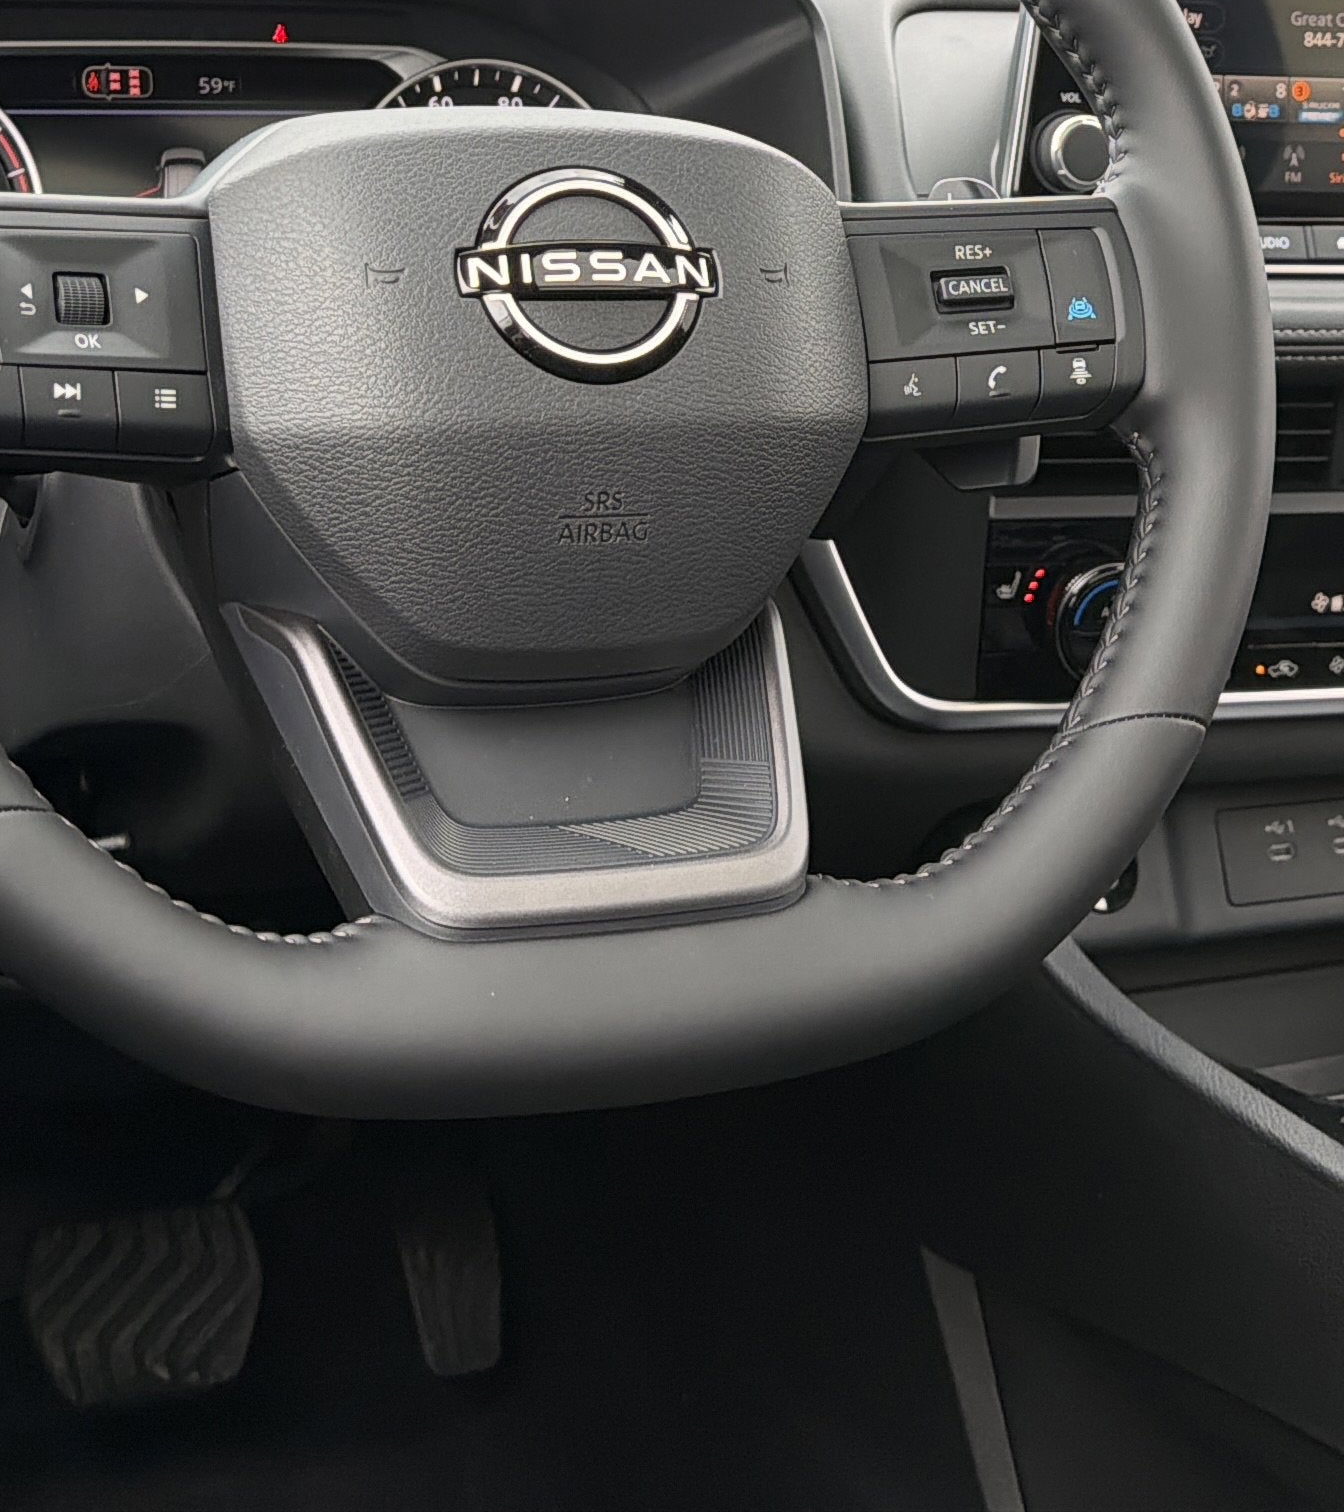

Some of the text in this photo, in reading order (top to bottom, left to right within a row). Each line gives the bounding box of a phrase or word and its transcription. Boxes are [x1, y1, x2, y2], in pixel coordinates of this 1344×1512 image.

[1290, 11, 1332, 28] Great
[1060, 92, 1082, 104] VOL
[1230, 83, 1239, 97] 2
[1275, 83, 1287, 99] 8
[1284, 172, 1302, 183] FM
[1260, 236, 1289, 249] UDIO
[955, 245, 993, 260] RES+
[467, 251, 711, 289] NISSAN
[948, 279, 1008, 295] CANCEL
[74, 334, 101, 349] OK
[583, 490, 624, 512] SRS
[557, 521, 650, 544] AIRBAG
